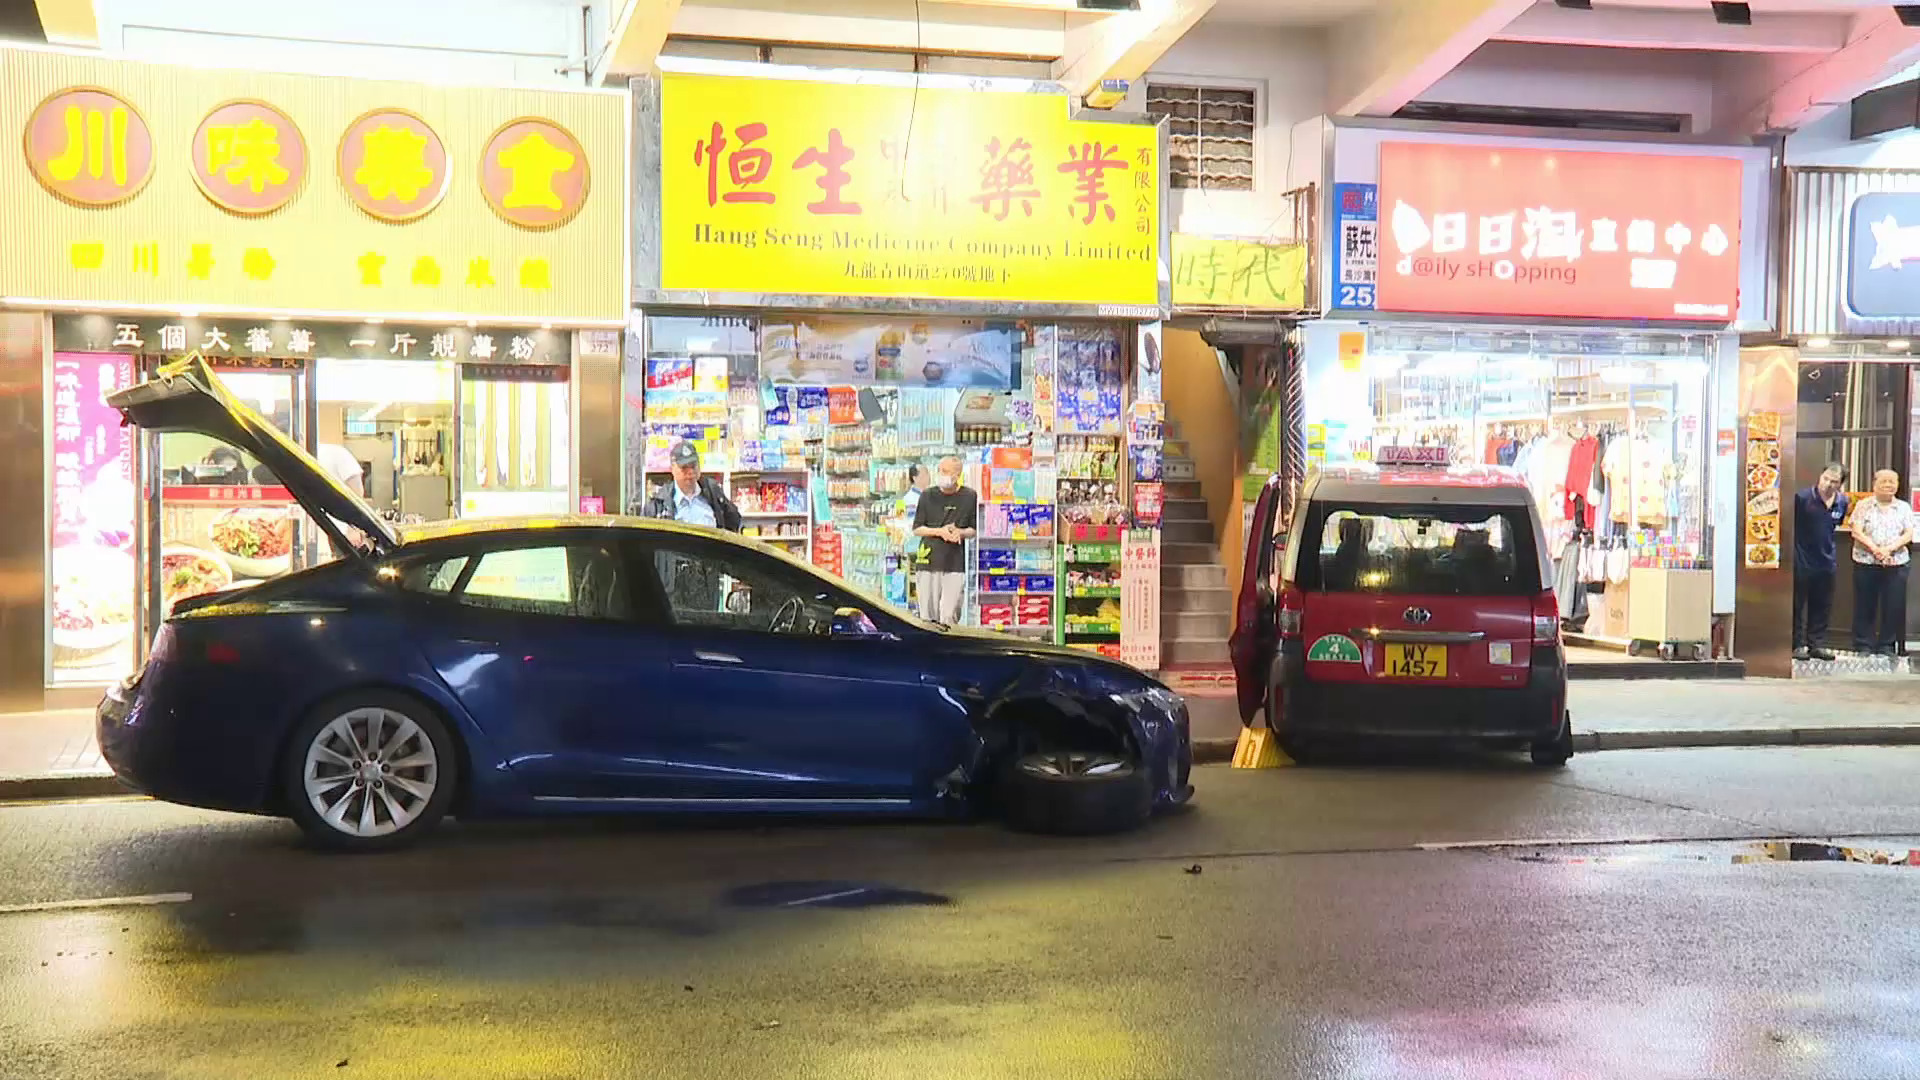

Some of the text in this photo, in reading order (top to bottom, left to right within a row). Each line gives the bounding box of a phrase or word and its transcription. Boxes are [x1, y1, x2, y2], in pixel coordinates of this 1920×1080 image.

[694, 121, 1129, 226] 恒生藥業
[1134, 147, 1154, 236] 有限公司
[694, 223, 1151, 262] Hang Seng Medicine Company Limited
[1345, 225, 1376, 259] 蘇先
[1340, 285, 1374, 306] 25
[1383, 446, 1445, 461] TAXI
[1329, 643, 1341, 654] 4
[1404, 645, 1428, 660] WY
[1392, 660, 1439, 676] 1457
